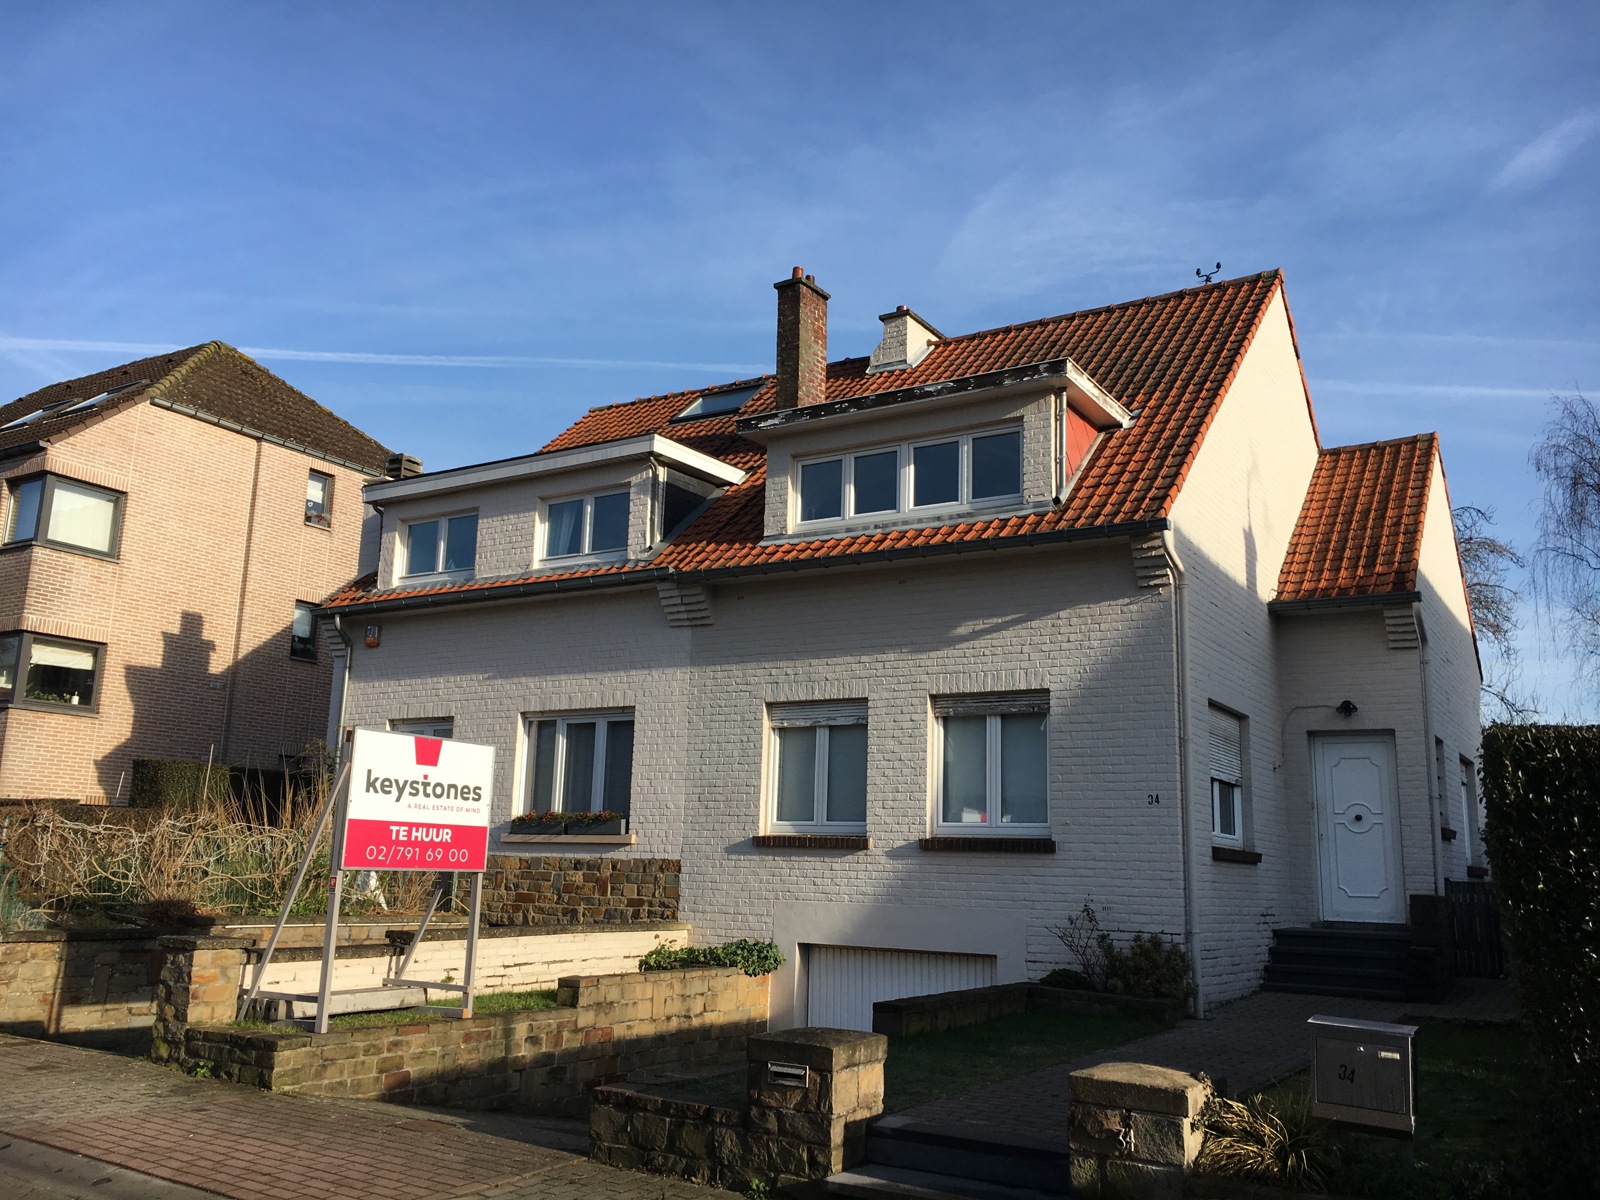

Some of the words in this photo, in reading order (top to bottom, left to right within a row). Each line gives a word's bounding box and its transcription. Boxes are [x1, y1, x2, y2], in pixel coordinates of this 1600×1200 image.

[365, 768, 482, 803] keystones
[431, 804, 454, 812] ESTATE
[1147, 793, 1160, 805] 34
[389, 825, 409, 841] TE
[411, 826, 453, 843] HUUR
[366, 845, 420, 865] 02/791
[425, 848, 443, 862] 69
[448, 849, 469, 863] 00
[1338, 1064, 1356, 1084] 34
[1115, 1127, 1136, 1152] 34
